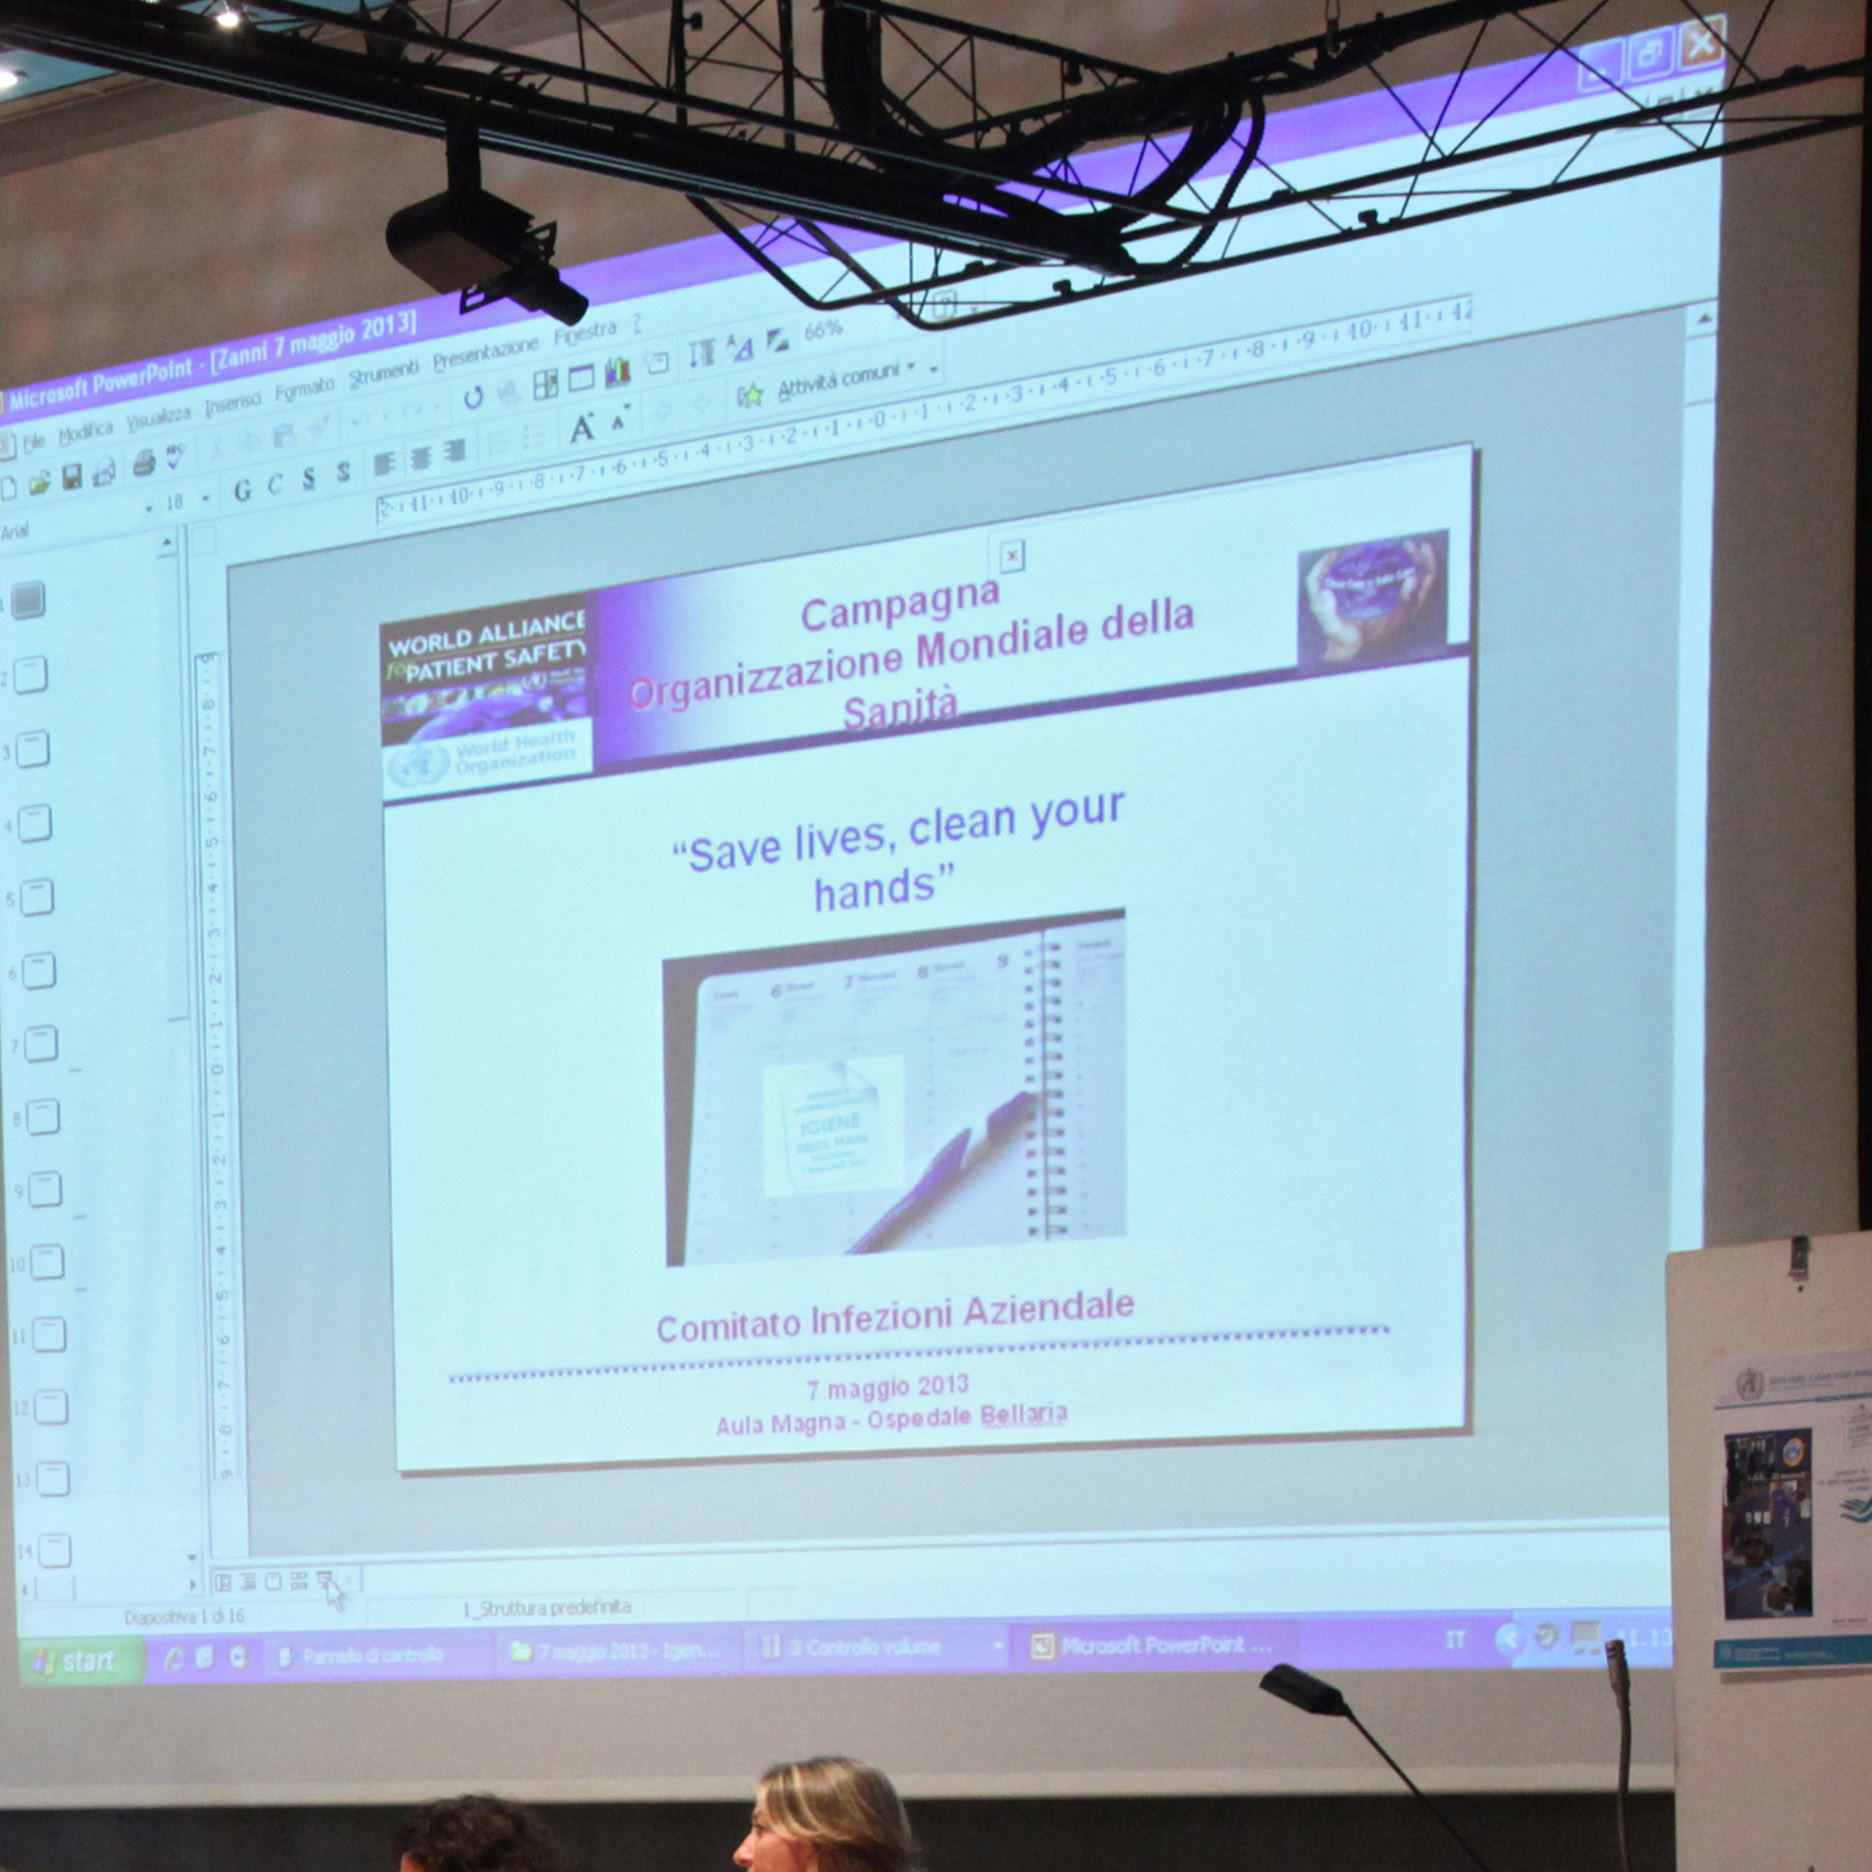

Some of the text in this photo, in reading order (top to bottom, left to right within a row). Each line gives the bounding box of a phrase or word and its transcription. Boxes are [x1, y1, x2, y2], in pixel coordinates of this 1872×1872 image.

[804, 318, 844, 342] 66%
[9, 307, 418, 413] Microsoft PowerPoint [Zanni 7 maggio 2013]
[23, 433, 46, 455] File
[58, 419, 114, 449] Modifica
[126, 404, 192, 435] Visualizza
[205, 391, 262, 419] Inserisci
[275, 375, 336, 404] Formato
[349, 358, 420, 391] Strumenti
[433, 333, 540, 374] Presentazione
[554, 319, 617, 348] Finestra
[777, 359, 900, 402] Attività comuni
[166, 494, 183, 512] 18
[235, 480, 252, 502] G
[1, 522, 30, 541] Arial
[802, 579, 1000, 631] Campagna
[388, 609, 586, 658] WORLD ALLIANCE
[407, 651, 498, 682] PATIENT
[630, 645, 903, 711] Organizzazione
[915, 612, 1088, 668] Mondiale
[1101, 596, 1194, 639] della
[843, 684, 958, 731] Sanità
[456, 728, 576, 759] World Health
[455, 747, 576, 776] Organization
[796, 823, 896, 860] lives,
[910, 804, 1015, 845] clean
[1031, 791, 1126, 840] your
[657, 1288, 1136, 1344] Comitato Infezioni Aziendale
[807, 1373, 970, 1403] 7 maggio 2013
[716, 1402, 1068, 1438] Aula Magna Ospedale Bellaria
[212, 1608, 225, 1625] di
[228, 1607, 245, 1624] 16
[551, 1597, 632, 1619] predefinita
[807, 1637, 874, 1657] Controllo
[1063, 1634, 1245, 1655] Microsoft PowerPoint
[1446, 1629, 1466, 1649] IT
[63, 1649, 115, 1674] start
[382, 1645, 443, 1664] controllo
